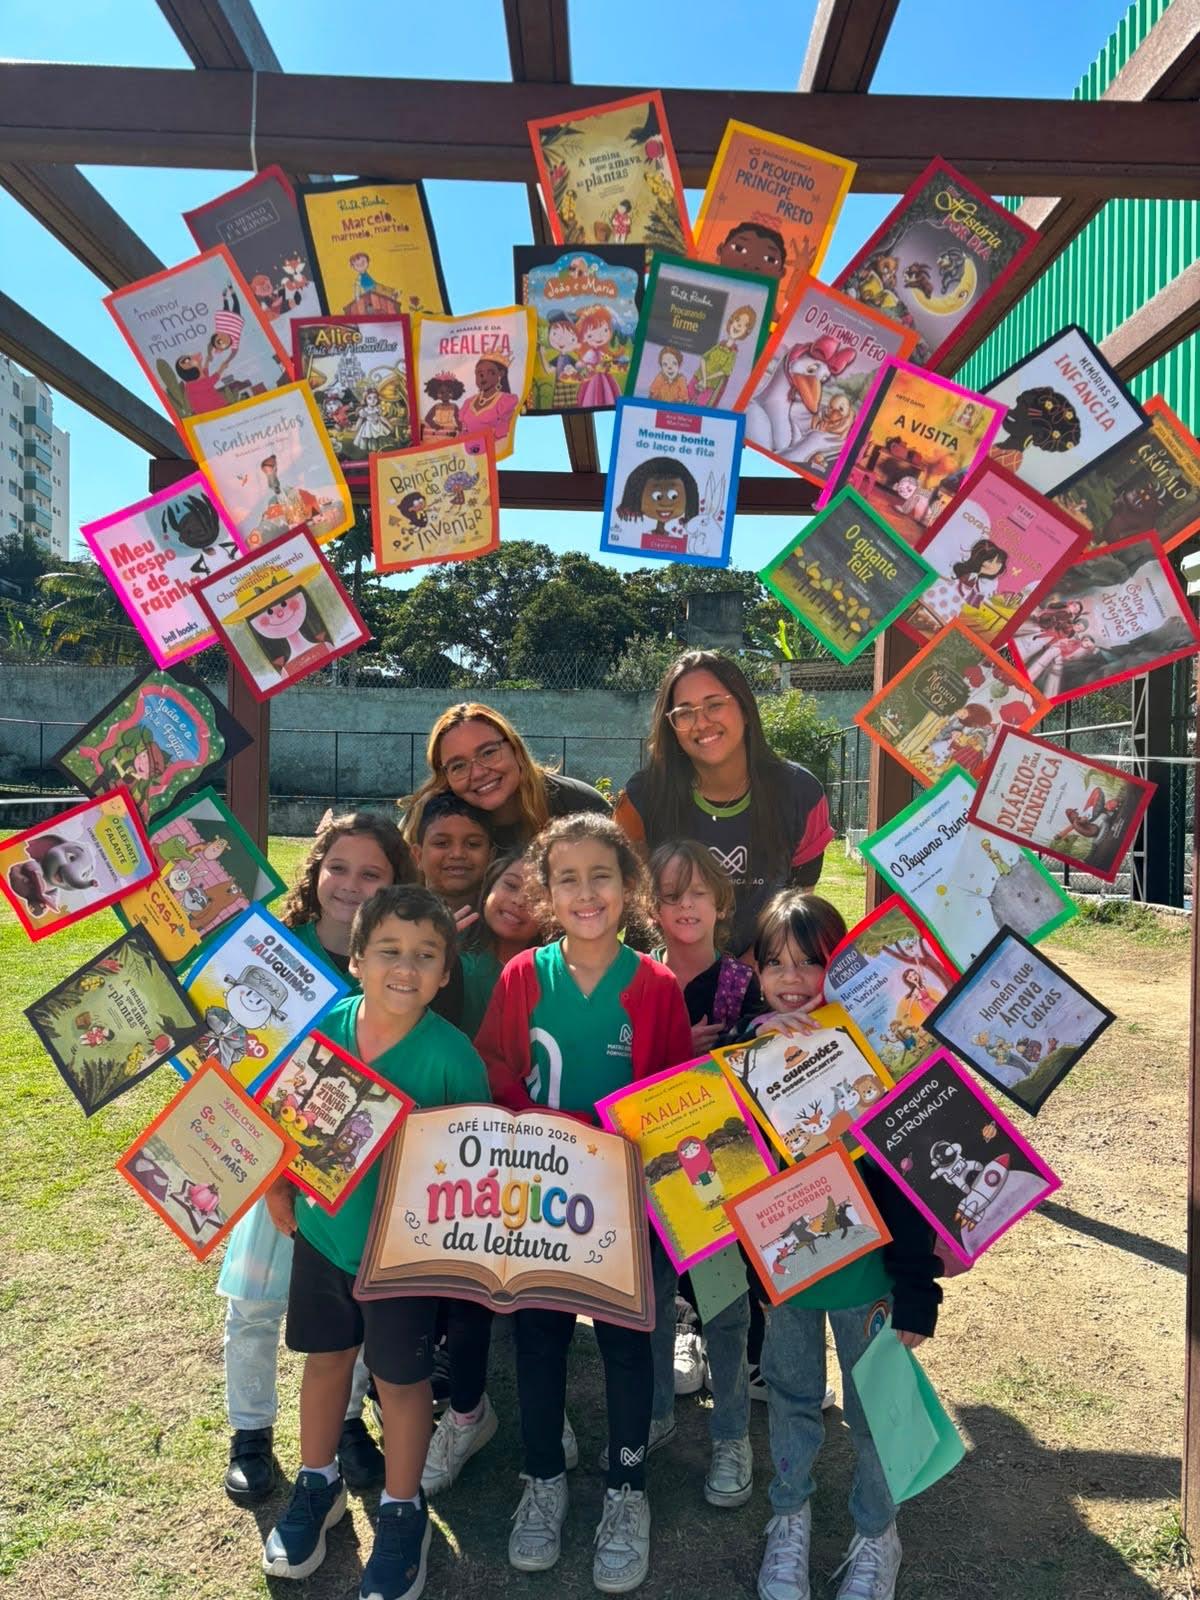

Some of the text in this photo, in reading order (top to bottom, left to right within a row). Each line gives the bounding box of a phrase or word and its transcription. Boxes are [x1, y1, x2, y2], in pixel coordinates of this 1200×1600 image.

[578, 151, 620, 168] A menina
[608, 155, 642, 170] amava
[750, 158, 758, 170] O
[761, 161, 815, 190] PEQUENO
[584, 168, 629, 191] plantas
[736, 168, 793, 200] PRÍNCIPE
[341, 211, 397, 232] Marcelo,
[776, 200, 814, 225] PRETO
[374, 224, 410, 234] martelo
[138, 298, 180, 323] melhor
[160, 300, 210, 332] mãe
[672, 315, 699, 332] firme
[149, 322, 208, 356] mundo
[314, 328, 363, 346] Alice
[439, 334, 511, 356] REALEZA
[805, 306, 818, 323] O
[860, 336, 887, 362] FEIO
[1054, 353, 1116, 432] INFÂNCIA
[1078, 356, 1120, 409] MEMÓRIAS DA
[212, 414, 305, 456] Sentimentos
[638, 428, 716, 447] Menina bonita
[894, 414, 959, 451] A VISITA
[636, 440, 715, 458] do laço de fita
[1158, 449, 1168, 457] O
[1138, 444, 1187, 500] GRÚFALO
[110, 539, 156, 568] Meu
[122, 548, 176, 582] crespo
[846, 524, 861, 540] O
[854, 537, 898, 581] gigante
[846, 552, 874, 584] feliz
[132, 572, 170, 600] é de
[216, 550, 304, 604] Chapeuzinho Amarelo
[230, 570, 252, 586] Chico
[1102, 592, 1130, 637] dragões
[1126, 584, 1148, 617] Entre
[161, 630, 178, 644] bell
[176, 622, 199, 638] hooks
[997, 765, 1036, 829] DIÁRIO
[1016, 758, 1062, 838] MINHOCA
[104, 827, 128, 865] FALANTE
[112, 817, 140, 864] O ELEFANTE
[890, 862, 904, 878] O
[898, 834, 944, 872] Pequeno
[151, 891, 178, 934] CASA
[264, 935, 276, 946] O
[243, 934, 317, 1002] MALUQUINHO
[830, 950, 858, 980] MONTEIRO
[836, 962, 861, 985] LOBATO
[124, 978, 148, 1016] A menina
[840, 970, 879, 1002] Reinações
[853, 976, 888, 1004] Narizinho
[978, 962, 1034, 1022] Homem que
[990, 979, 1000, 990] O
[108, 990, 138, 1030] plantas
[1000, 980, 1043, 1028] Amava
[1020, 988, 1062, 1030] Caixas
[131, 1006, 152, 1036] amava
[248, 1038, 265, 1057] 40
[766, 1082, 782, 1095] OS
[783, 1040, 840, 1084] GUARDIÕES
[338, 1080, 344, 1089] A
[772, 1092, 782, 1102] DO
[200, 1106, 216, 1125] Se
[307, 1102, 337, 1127] MORDIA
[316, 1088, 347, 1114] ZINHA
[640, 1085, 712, 1130] MALALA
[885, 1079, 940, 1128] O Pequeno
[448, 1117, 578, 1144] CAFÉ LITERÁRIO 2026
[886, 1085, 958, 1152] ASTRONAUTA
[220, 1154, 248, 1184] MÃES
[458, 1134, 570, 1176] O mundo
[426, 1168, 595, 1235] mágico
[756, 1198, 785, 1220] MUITO
[786, 1176, 828, 1204] CANSADO
[760, 1220, 766, 1229] E
[768, 1211, 786, 1225] BEM
[787, 1184, 832, 1214] ACORDADO
[442, 1222, 572, 1262] da leitura
